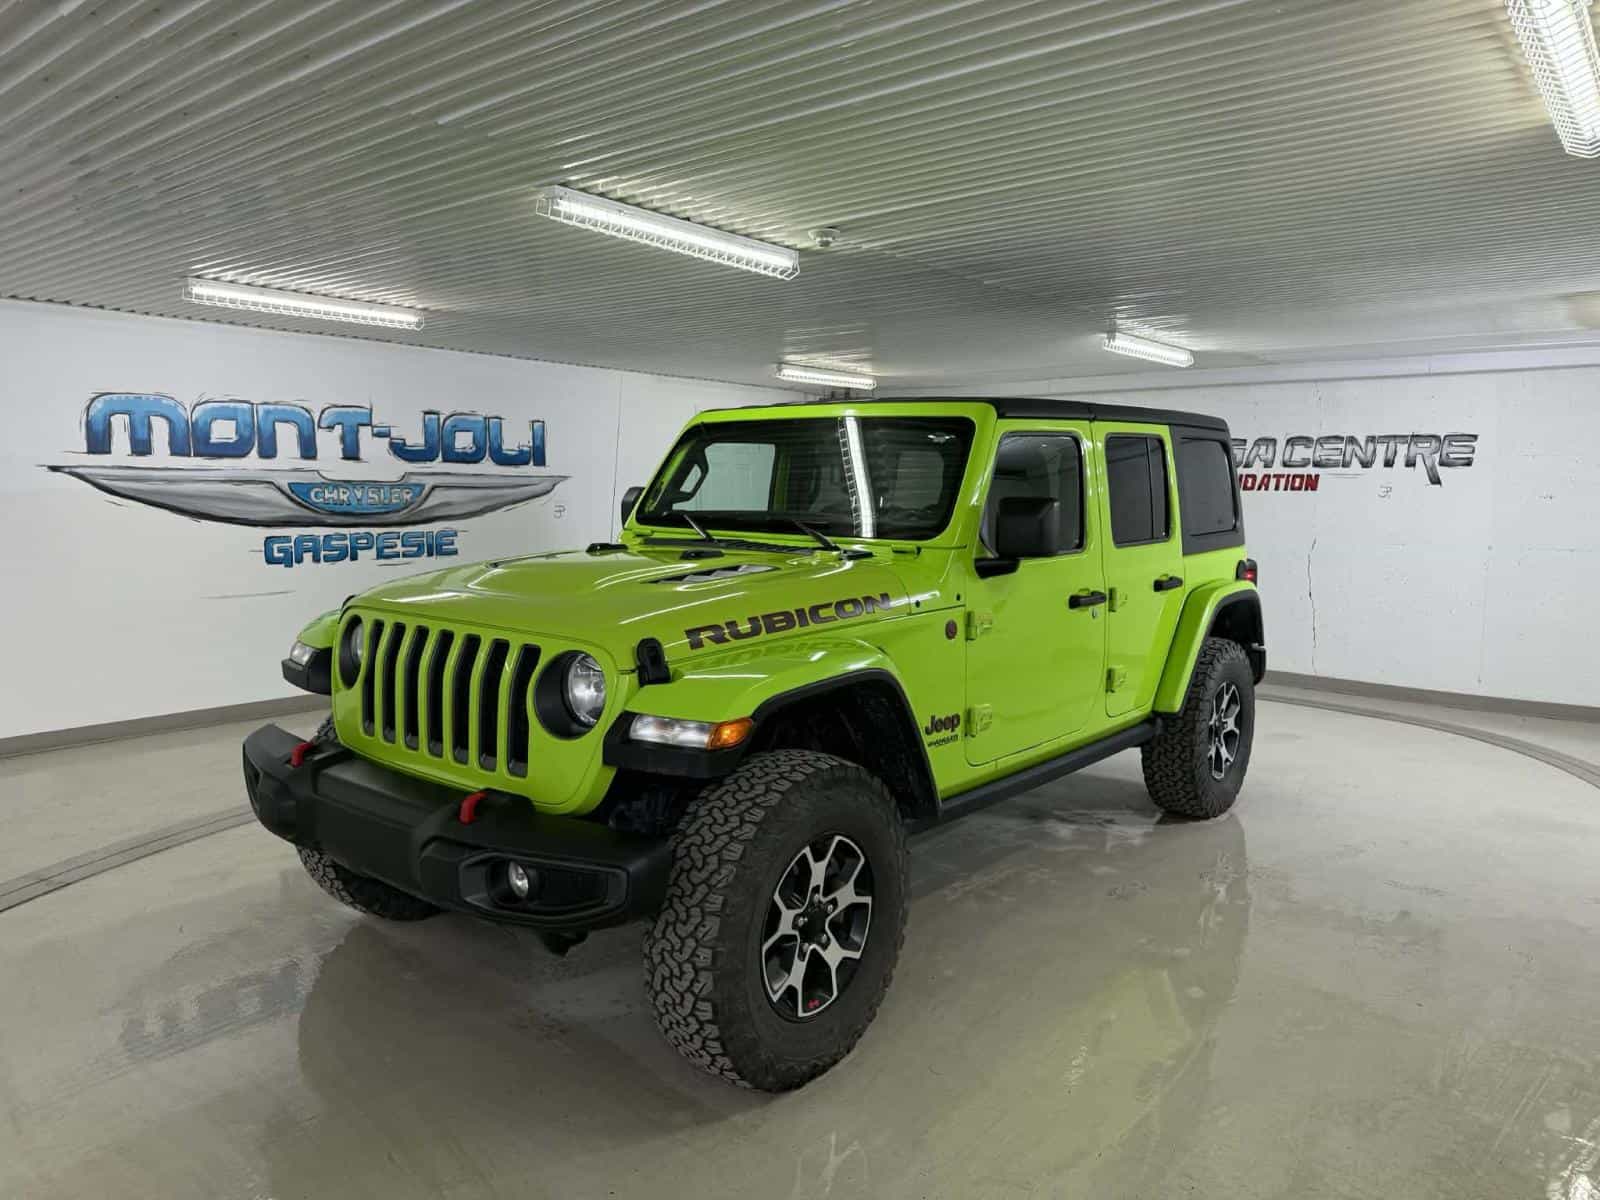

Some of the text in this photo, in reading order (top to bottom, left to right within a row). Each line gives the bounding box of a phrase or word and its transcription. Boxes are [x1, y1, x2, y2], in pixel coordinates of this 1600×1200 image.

[86, 393, 547, 467] MONT-JOLI
[309, 486, 414, 506] CHRYSLER
[263, 530, 459, 567] GASPESIE
[684, 592, 892, 650] RUBICON
[924, 713, 961, 735] Jeep
